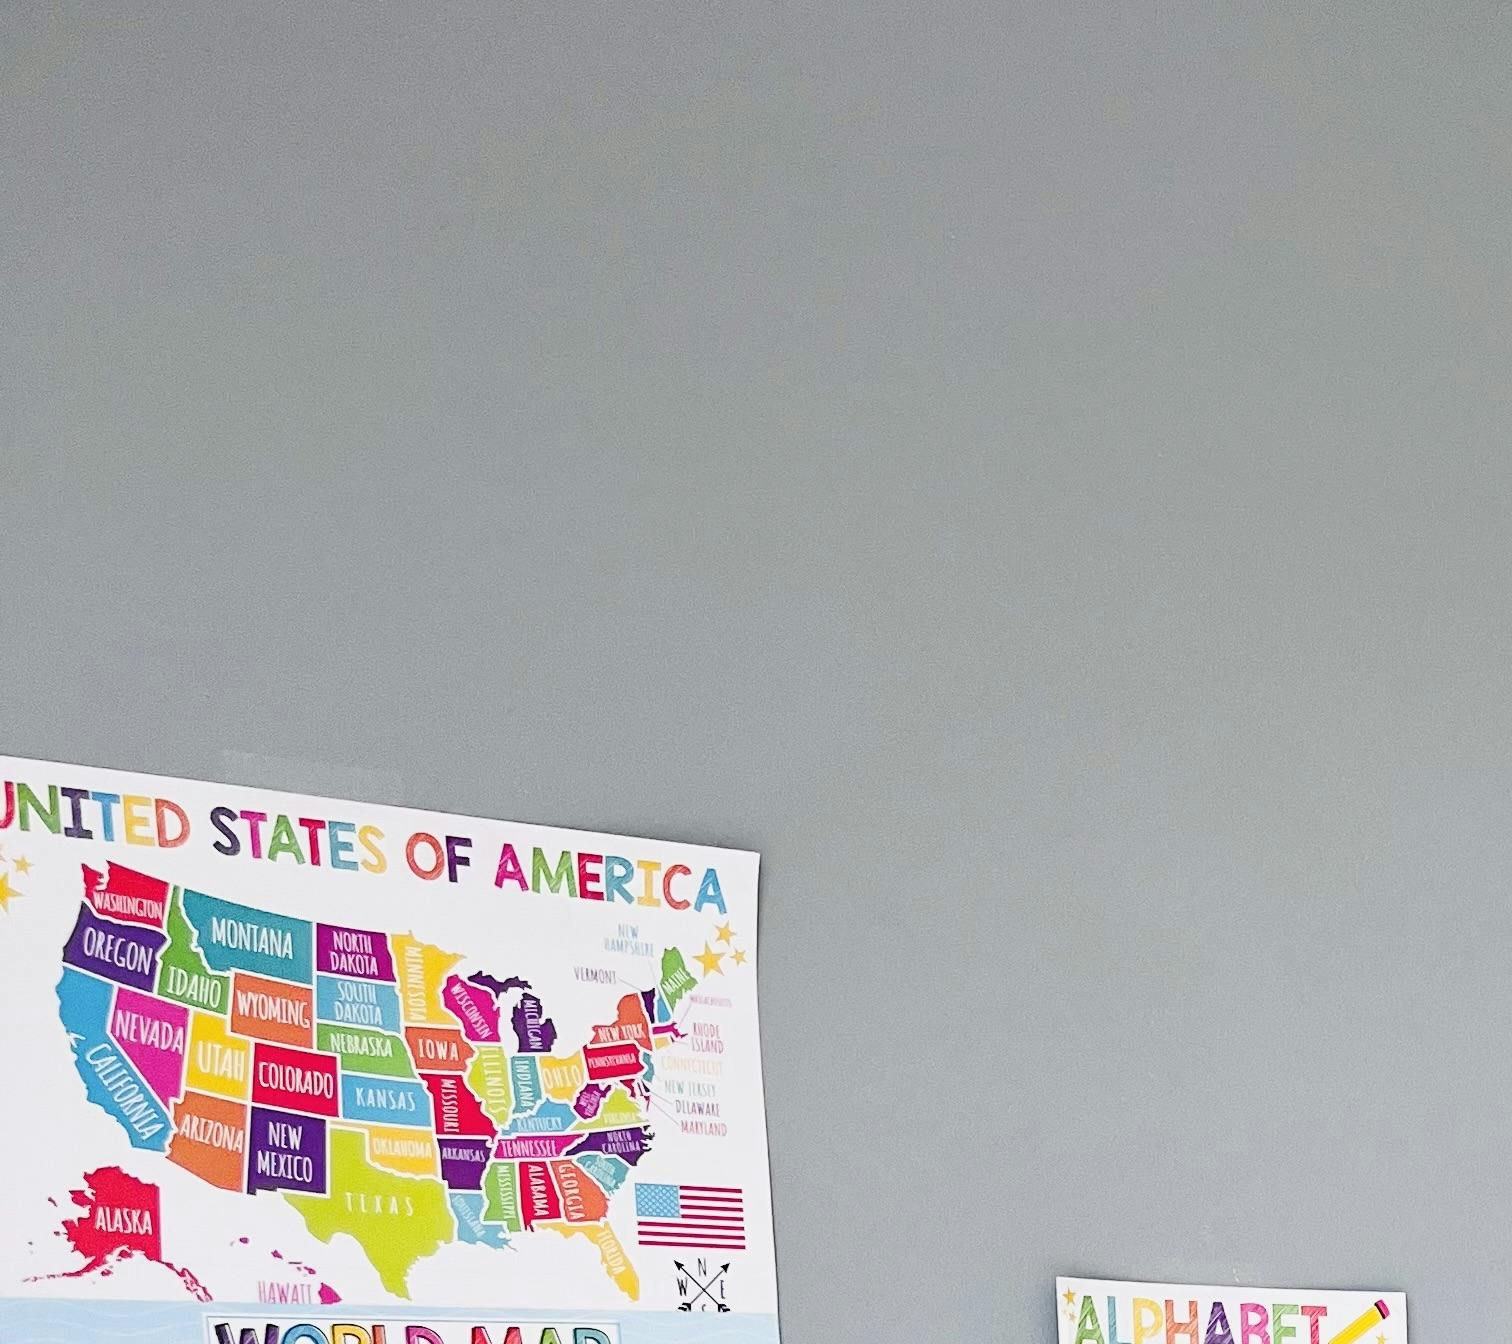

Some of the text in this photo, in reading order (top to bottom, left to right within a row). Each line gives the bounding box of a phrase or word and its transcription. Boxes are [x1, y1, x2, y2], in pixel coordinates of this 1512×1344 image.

[210, 807, 387, 873] STATES
[406, 832, 472, 882] OF
[494, 843, 727, 914] AMERICA
[93, 891, 163, 920] WASHINGTON
[83, 926, 152, 976] OREGON
[211, 916, 293, 960] MONTANA
[332, 930, 372, 955] NORTH
[330, 952, 379, 976] DAKOTA
[575, 966, 617, 984] VERMONT
[168, 966, 221, 1008] IDAHO
[338, 981, 376, 1004] SOUTH
[406, 946, 426, 1021] MINNESOTA
[661, 967, 690, 995] MAINE
[236, 990, 311, 1029] WYOMING
[334, 1003, 383, 1025] DAKOTA
[451, 983, 491, 1039] WISCONSIN
[524, 999, 542, 1049] MICHIGAN
[116, 1012, 184, 1056] NEVADA
[330, 1032, 392, 1058] NEBRASKA
[598, 1023, 646, 1042] NEW YORK
[692, 1038, 723, 1053] ISLAND
[199, 1040, 245, 1082] UTAH
[418, 1036, 459, 1062] IOWA
[258, 1062, 333, 1099] COLORADO
[481, 1047, 506, 1119] ILLINOIS
[519, 1059, 534, 1109] INDIANA
[542, 1064, 581, 1089] OHIO
[85, 1043, 164, 1141] CALIFORNIA
[354, 1085, 416, 1114] KANSAS
[441, 1078, 459, 1133] MISSOURI
[181, 1114, 244, 1152] ARIZONA
[269, 1121, 302, 1150] NEW
[517, 1116, 562, 1132] KENTUCKY
[682, 1120, 727, 1136] MARYLAND
[371, 1136, 432, 1160] OKLAHOMA
[442, 1146, 485, 1162] ARKANSAS
[501, 1139, 558, 1158] TENNESSEE
[257, 1151, 312, 1182] MEXICO
[344, 1191, 414, 1218] TEXAS
[528, 1164, 549, 1216] ALABAMA
[558, 1164, 586, 1221] GEORGIA
[94, 1207, 152, 1236] ALASKA
[599, 1230, 623, 1275] FLORIDA
[698, 1258, 707, 1278] N
[677, 1277, 726, 1299] W E
